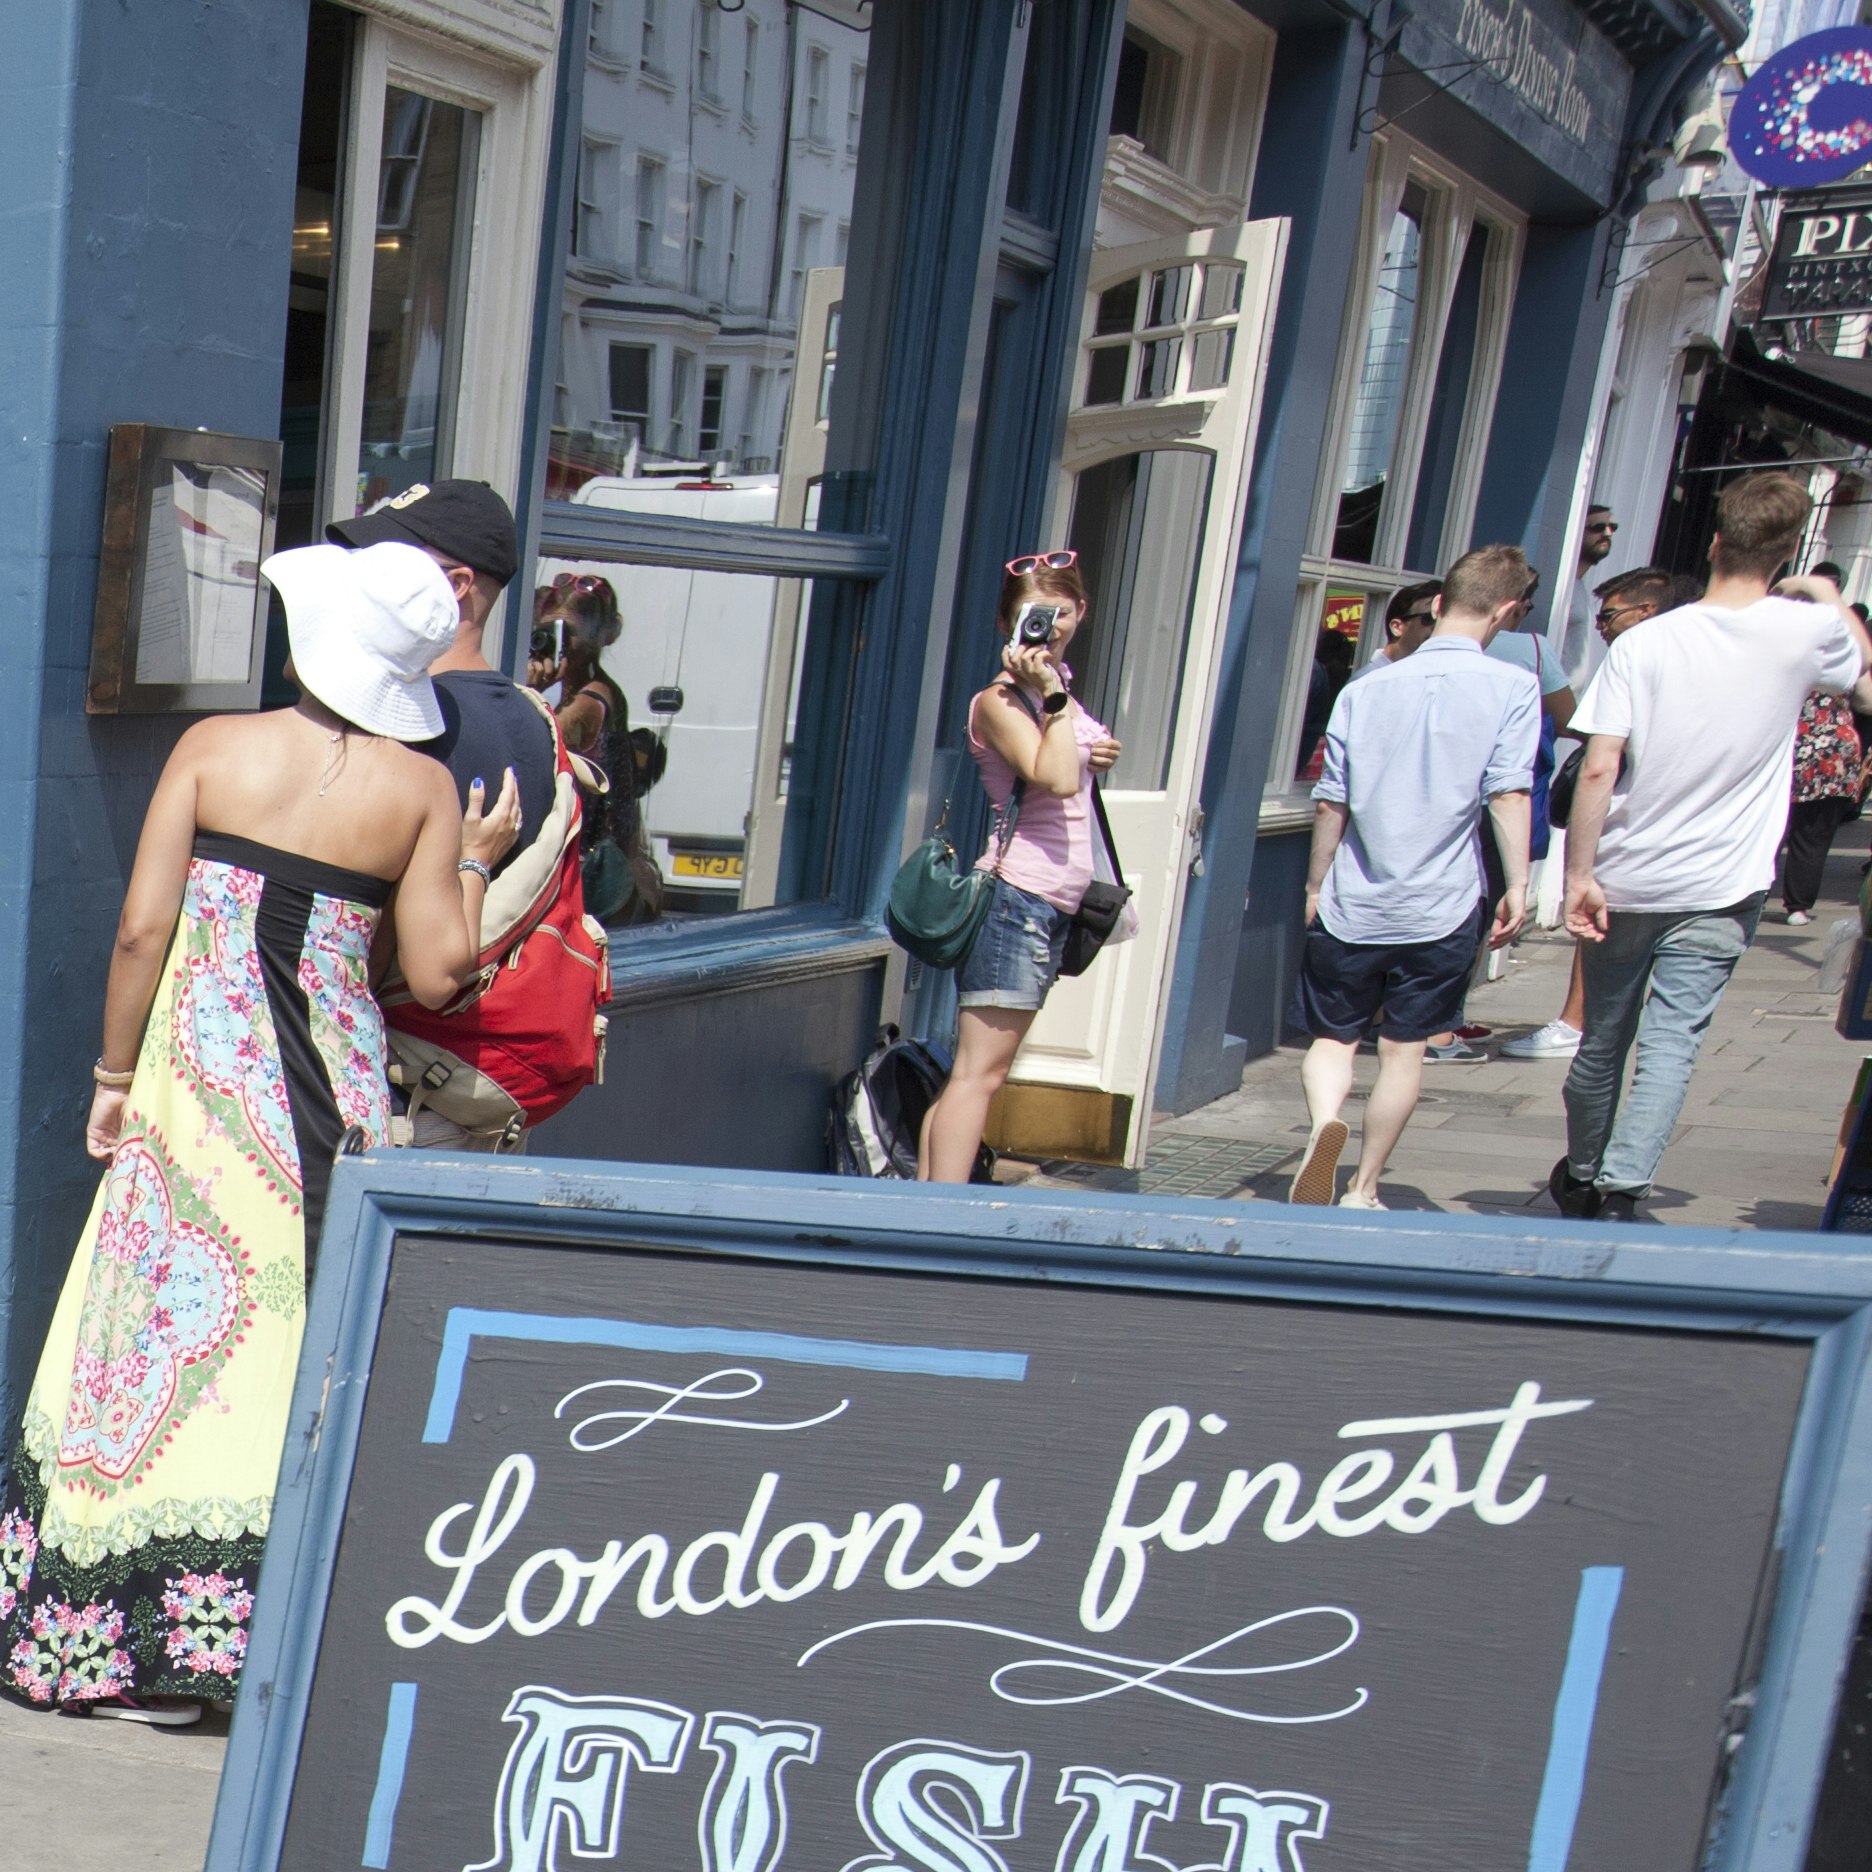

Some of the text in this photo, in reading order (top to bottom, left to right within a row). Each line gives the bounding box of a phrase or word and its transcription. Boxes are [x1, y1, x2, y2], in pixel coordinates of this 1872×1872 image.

[1785, 277, 1872, 307] TAPA
[384, 1380, 1593, 1648] London's finest
